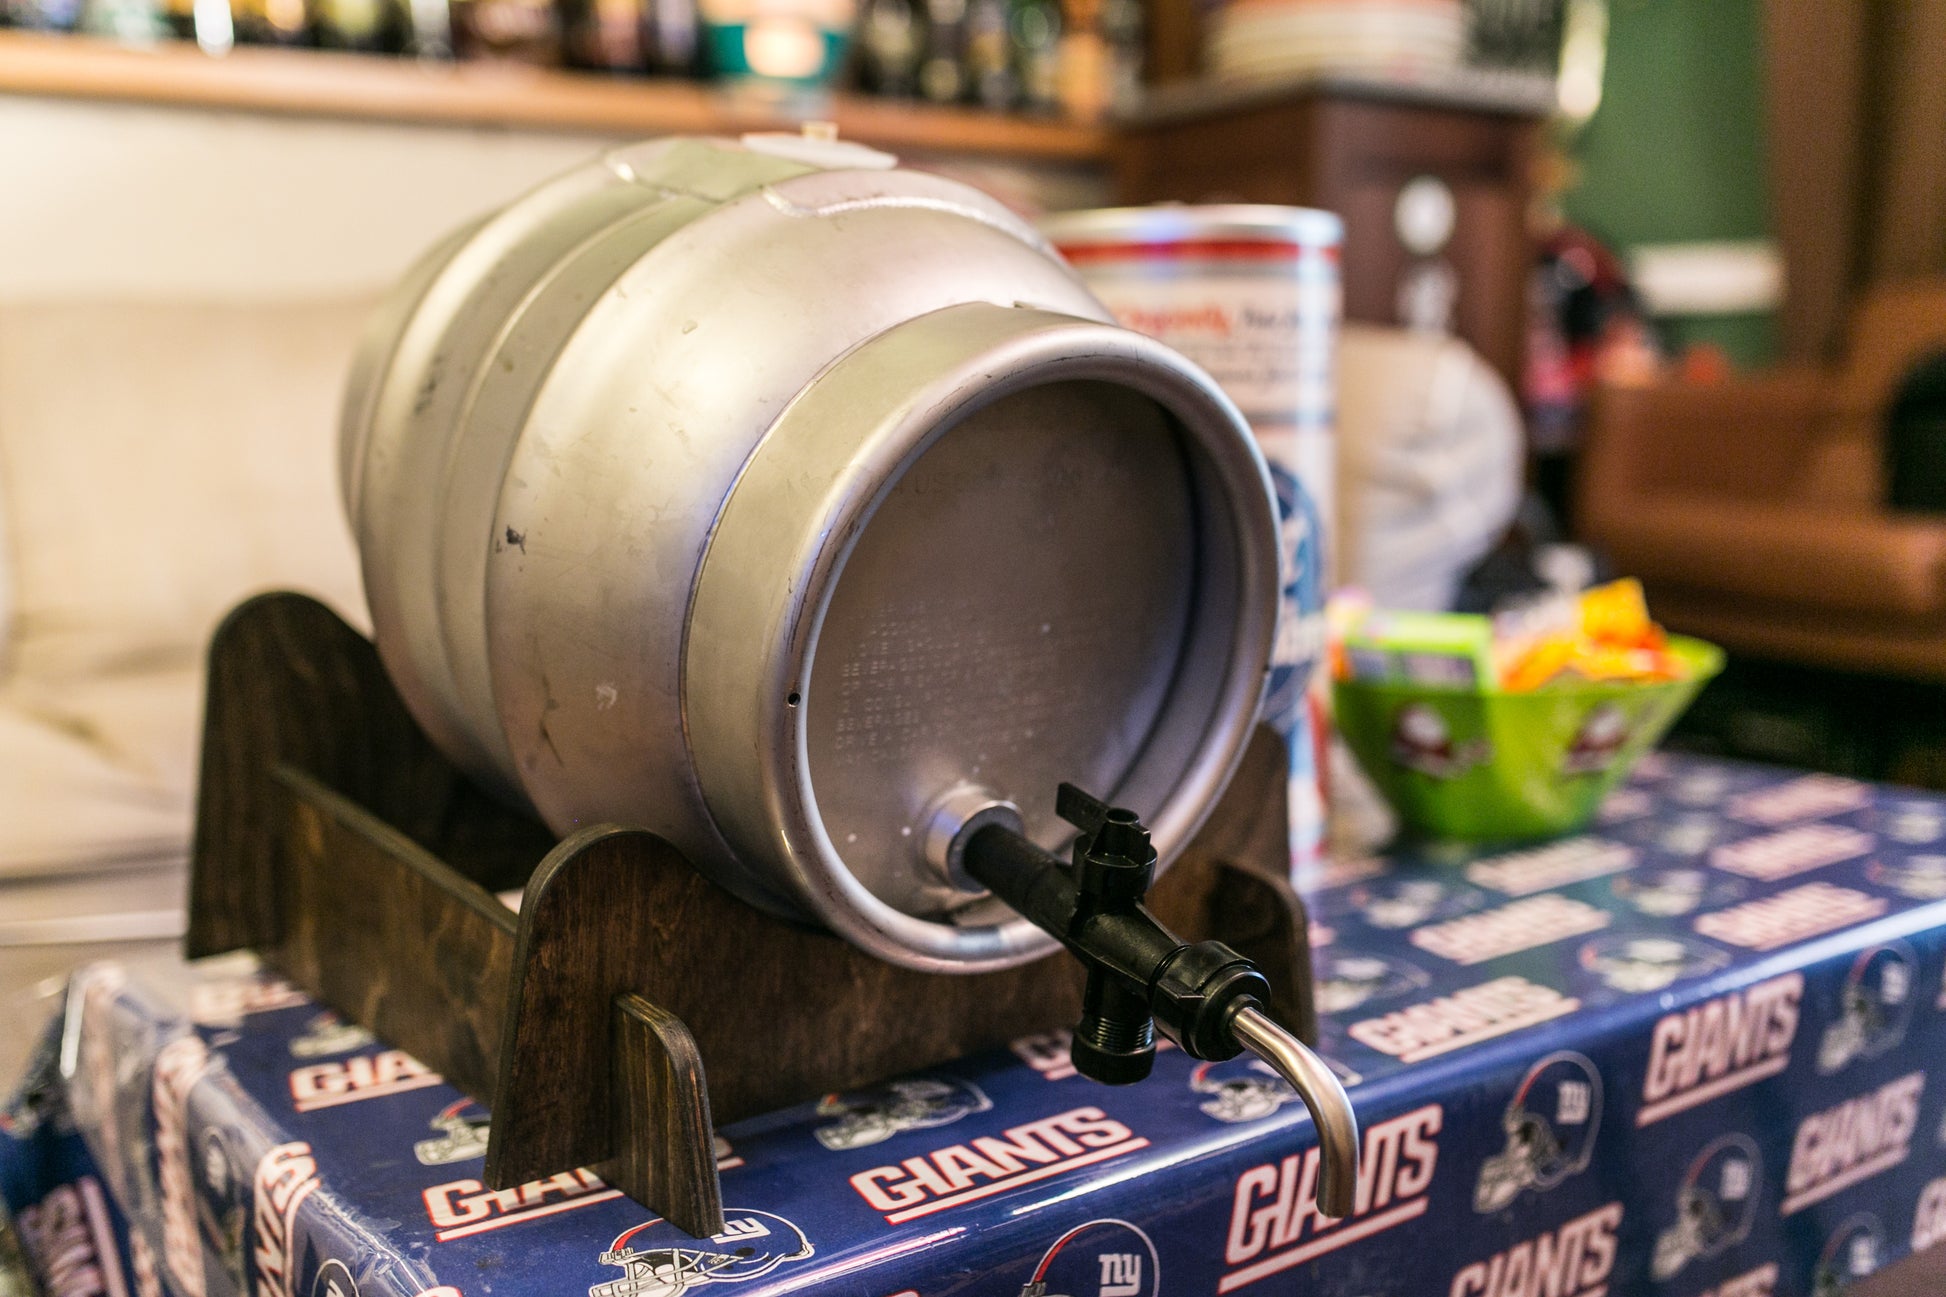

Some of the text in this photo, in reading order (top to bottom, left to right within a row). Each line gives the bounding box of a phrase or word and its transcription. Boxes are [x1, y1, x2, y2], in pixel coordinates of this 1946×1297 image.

[288, 1050, 432, 1101] GIA
[1643, 971, 1804, 1101] GIANTS
[849, 1106, 1134, 1212] GIANTS
